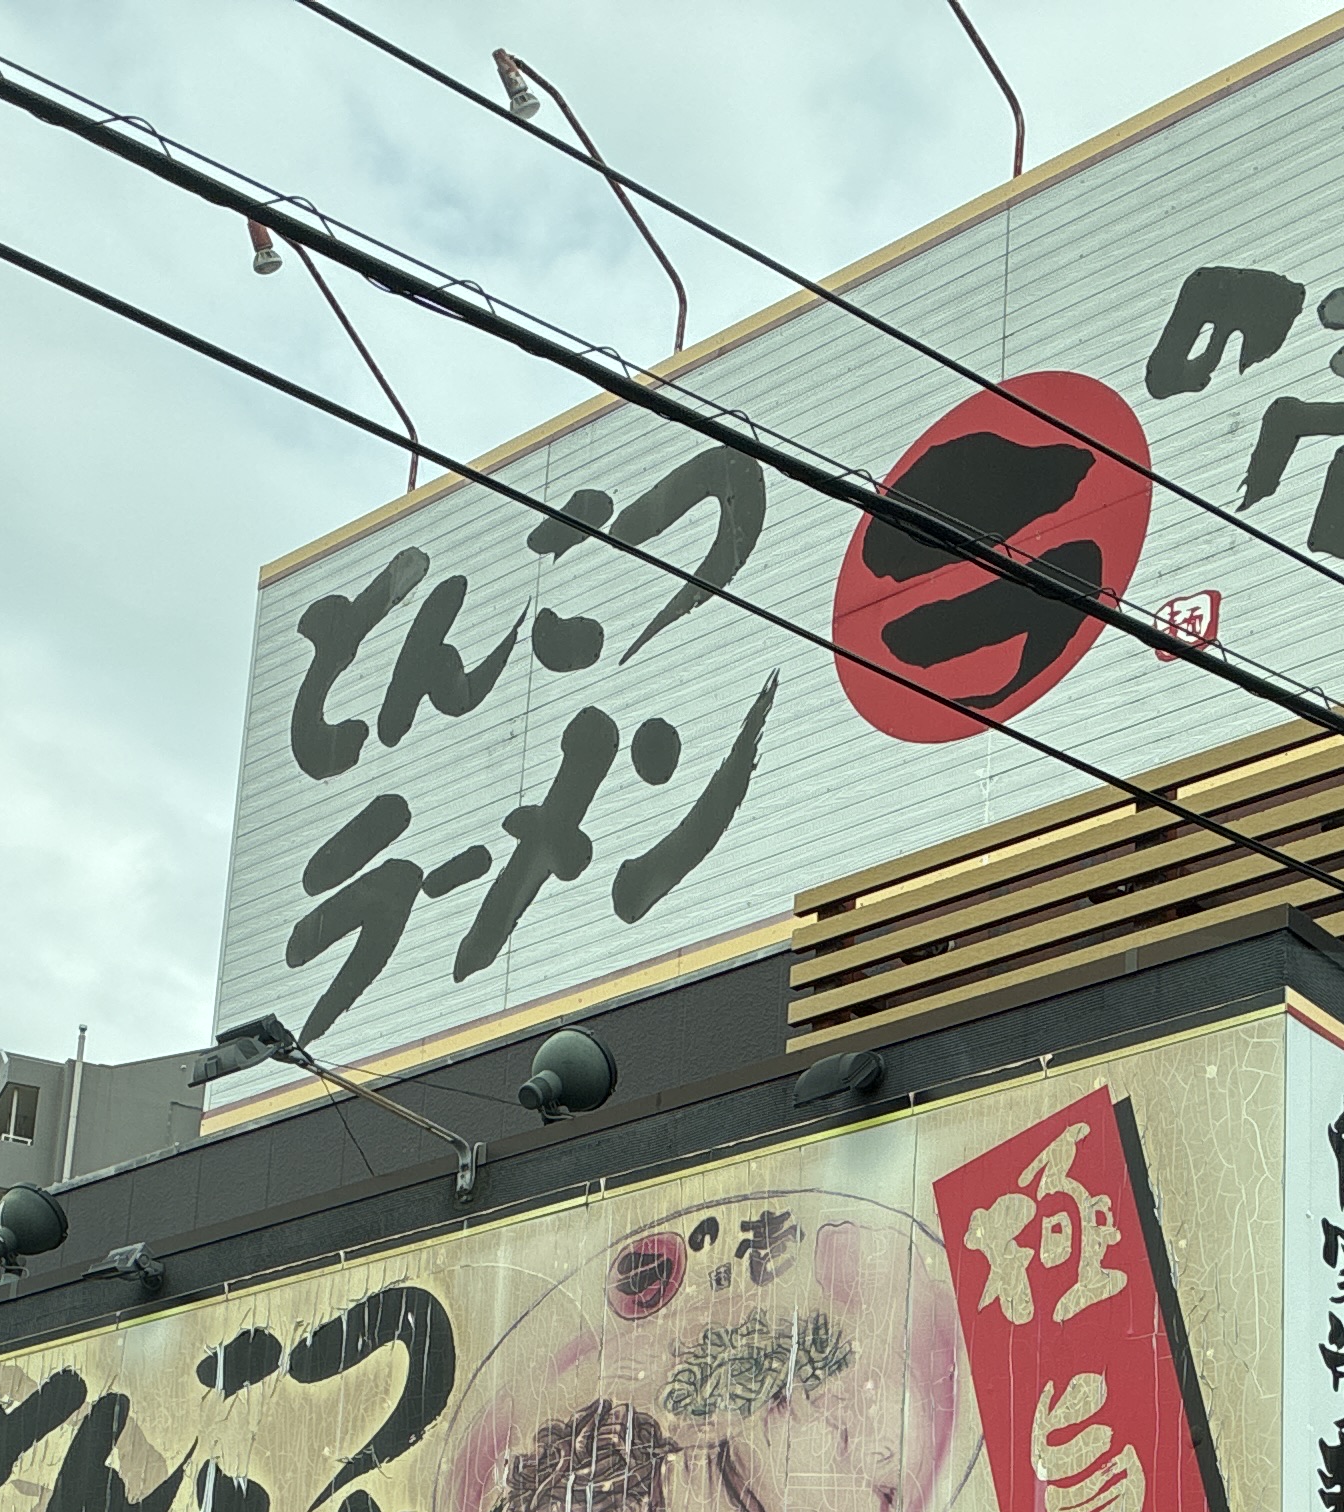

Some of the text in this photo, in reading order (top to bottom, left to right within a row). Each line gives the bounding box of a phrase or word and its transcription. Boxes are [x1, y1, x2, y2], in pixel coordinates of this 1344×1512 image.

[290, 442, 767, 781] とんこつ
[284, 668, 780, 1044] ラーメン
